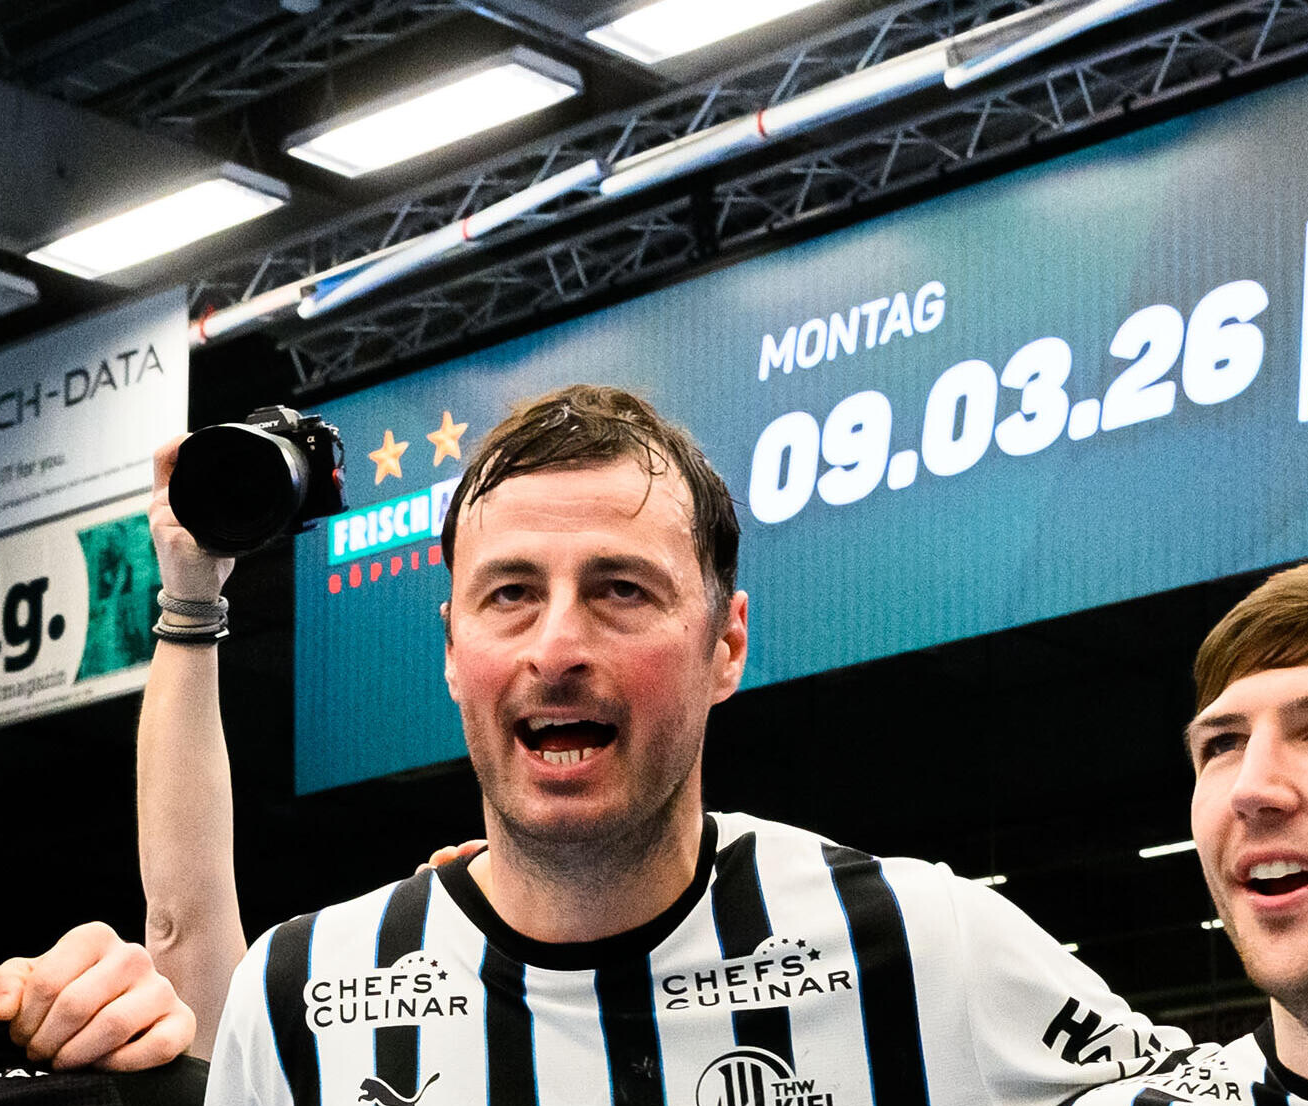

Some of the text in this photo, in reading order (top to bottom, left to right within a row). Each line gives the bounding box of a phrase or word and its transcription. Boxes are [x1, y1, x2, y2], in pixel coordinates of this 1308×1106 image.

[758, 280, 946, 381] MONTAG
[748, 279, 1268, 524] 09.03.26
[312, 974, 433, 1003] CHEFS
[662, 955, 806, 996] CHEFS
[666, 970, 853, 1010] CULINAR
[314, 996, 468, 1028] CULINAR
[771, 1079, 815, 1098] THW
